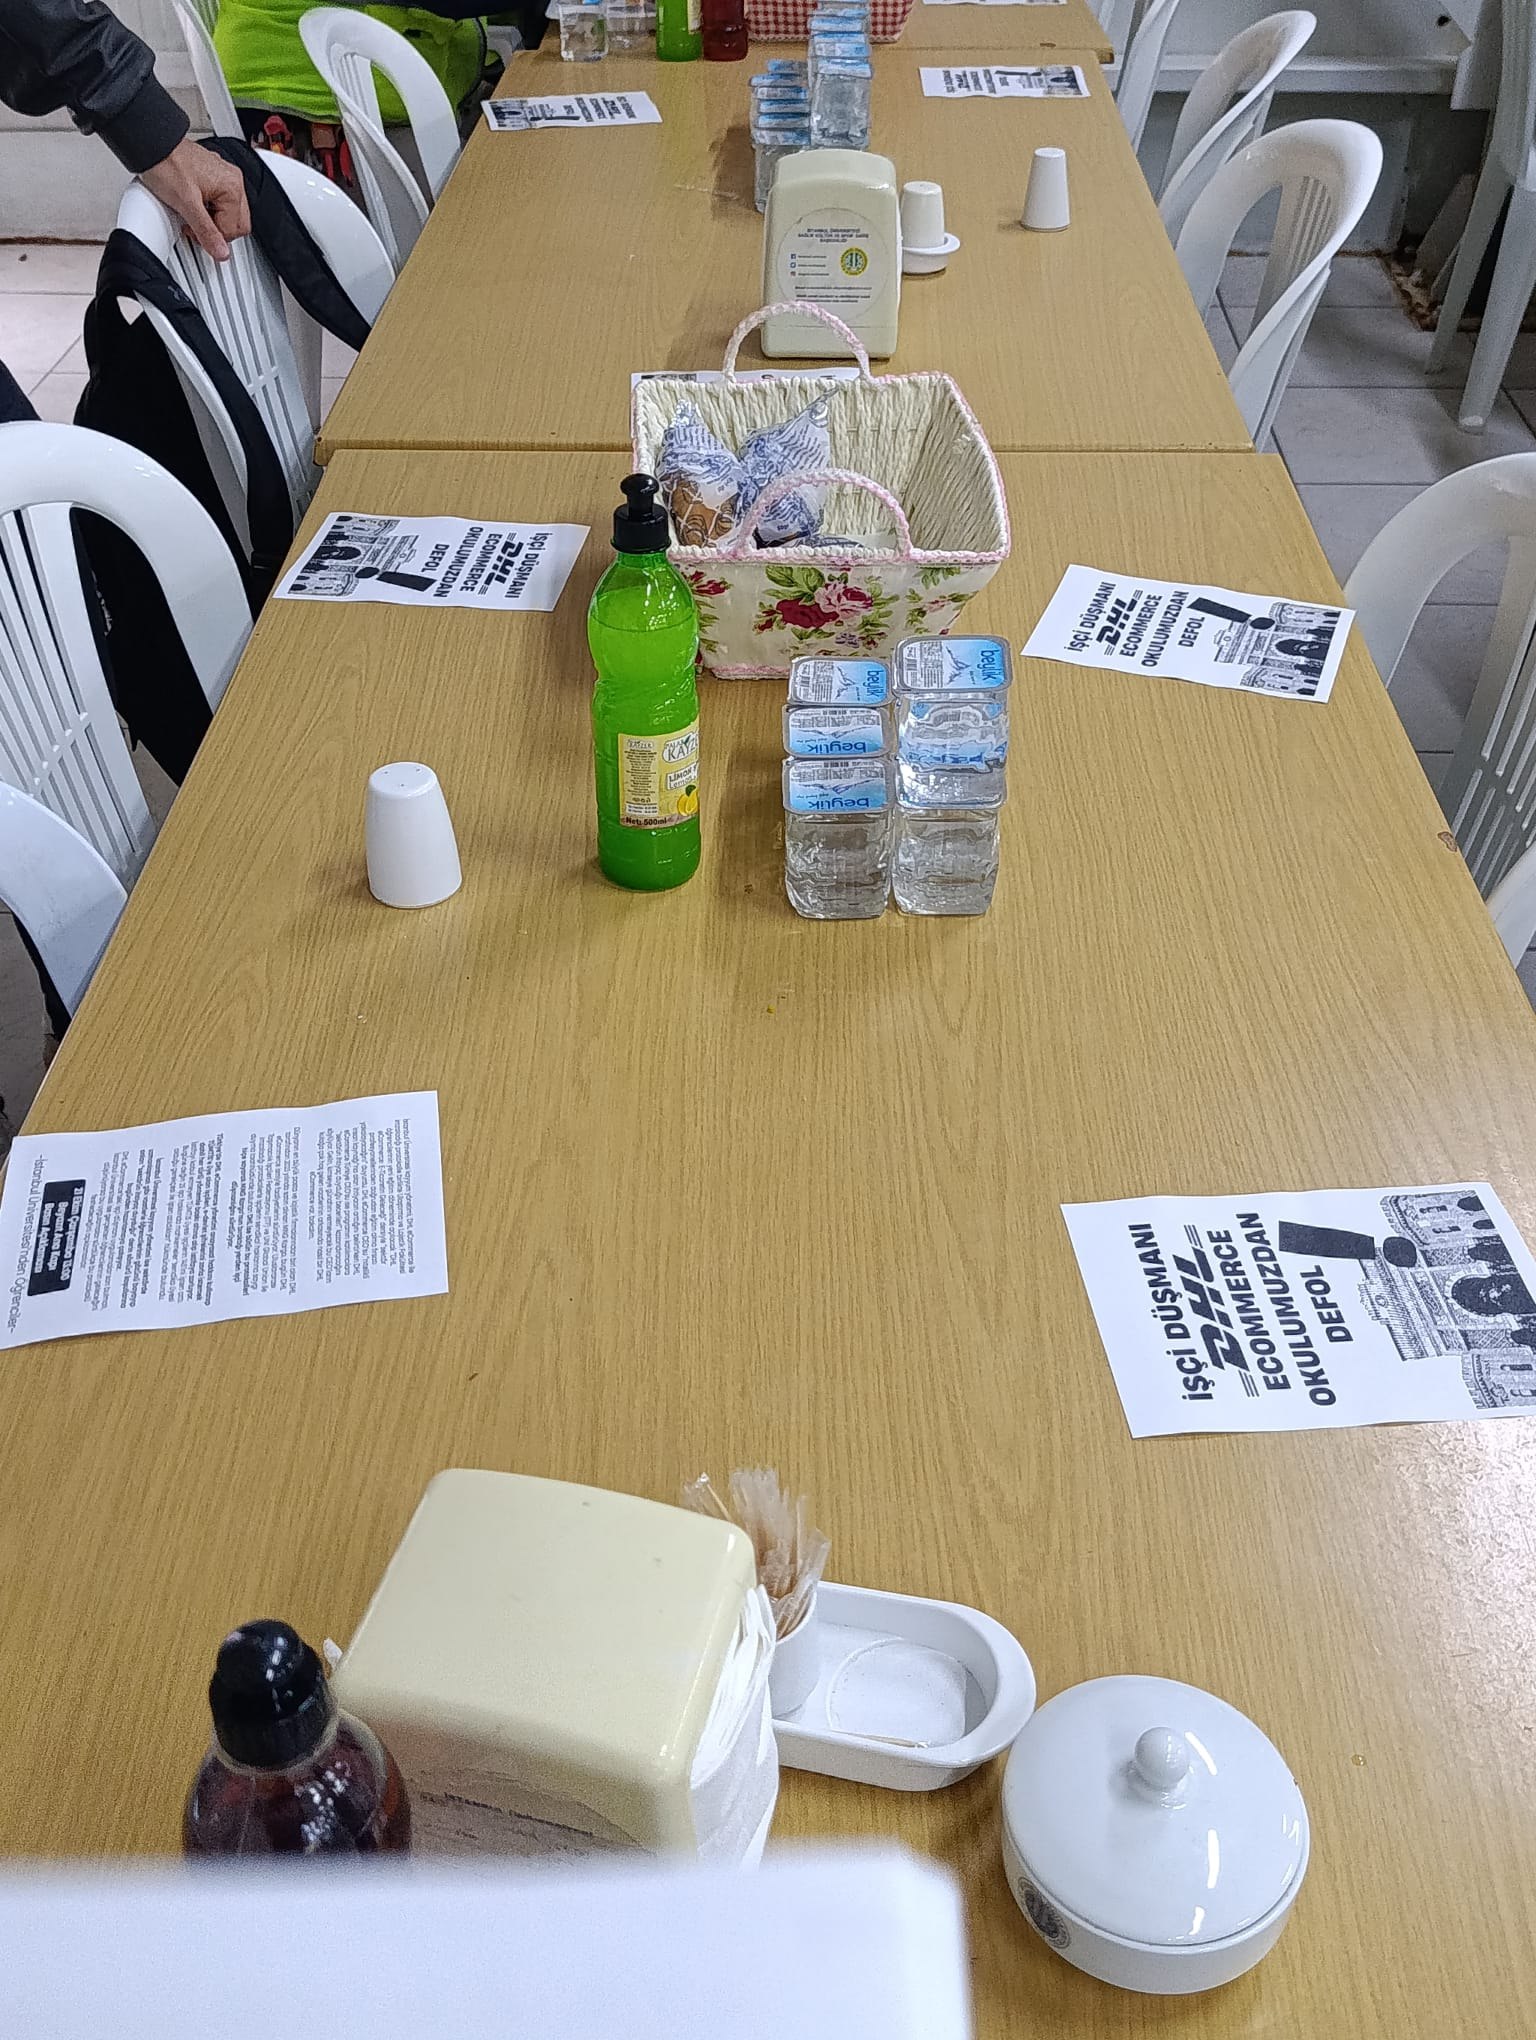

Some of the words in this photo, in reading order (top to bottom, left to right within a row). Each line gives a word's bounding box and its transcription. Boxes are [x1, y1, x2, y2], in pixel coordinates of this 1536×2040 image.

[429, 543, 449, 573] DEFOL
[433, 526, 483, 598] OKULUMUZDAN
[459, 533, 502, 592] ECOMMERCE
[485, 540, 523, 586] DHL
[528, 532, 553, 552] İŞÇİ
[504, 552, 540, 599] DÜŞMANI
[1064, 628, 1092, 652] İŞÇİ
[1083, 581, 1116, 630] DÜŞMANI
[1096, 598, 1137, 646] DHL
[1118, 594, 1163, 657] ECOMMERCE
[1141, 590, 1189, 668] OKULUMUZDAN
[1178, 615, 1205, 648] DEFOL
[863, 670, 884, 698] beylik
[977, 650, 1000, 681] beylik
[668, 735, 698, 760] KAYZ
[808, 741, 867, 754] beylik
[808, 797, 870, 810] beylik
[1127, 1223, 1191, 1341] DÜŞMANI
[1299, 1265, 1353, 1344] DEFOL
[1173, 1246, 1250, 1372] DHL
[1206, 1228, 1291, 1391] ECOMMERCE
[1235, 1212, 1336, 1406] OKULUMUZDAN
[1166, 1348, 1214, 1401] İŞÇİ
